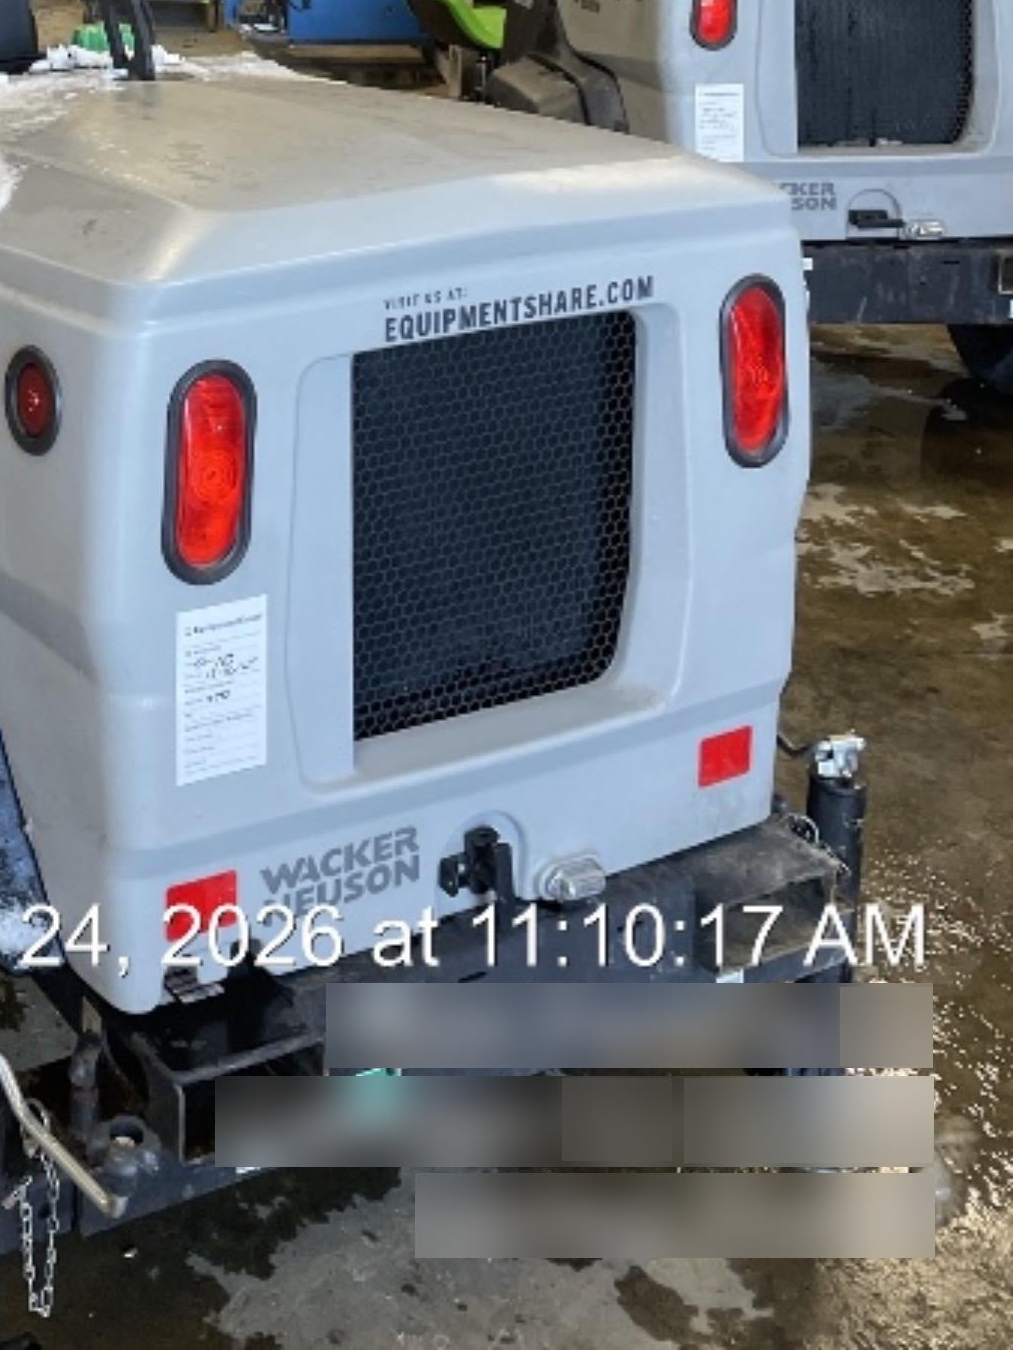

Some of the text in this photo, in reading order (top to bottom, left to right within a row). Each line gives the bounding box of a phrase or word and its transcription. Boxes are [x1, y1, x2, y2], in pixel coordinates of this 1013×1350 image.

[779, 182, 836, 196] CKER
[791, 197, 837, 211] SON
[385, 275, 654, 343] EQUIPMENTSHARE.COM
[260, 825, 420, 895] WACKER
